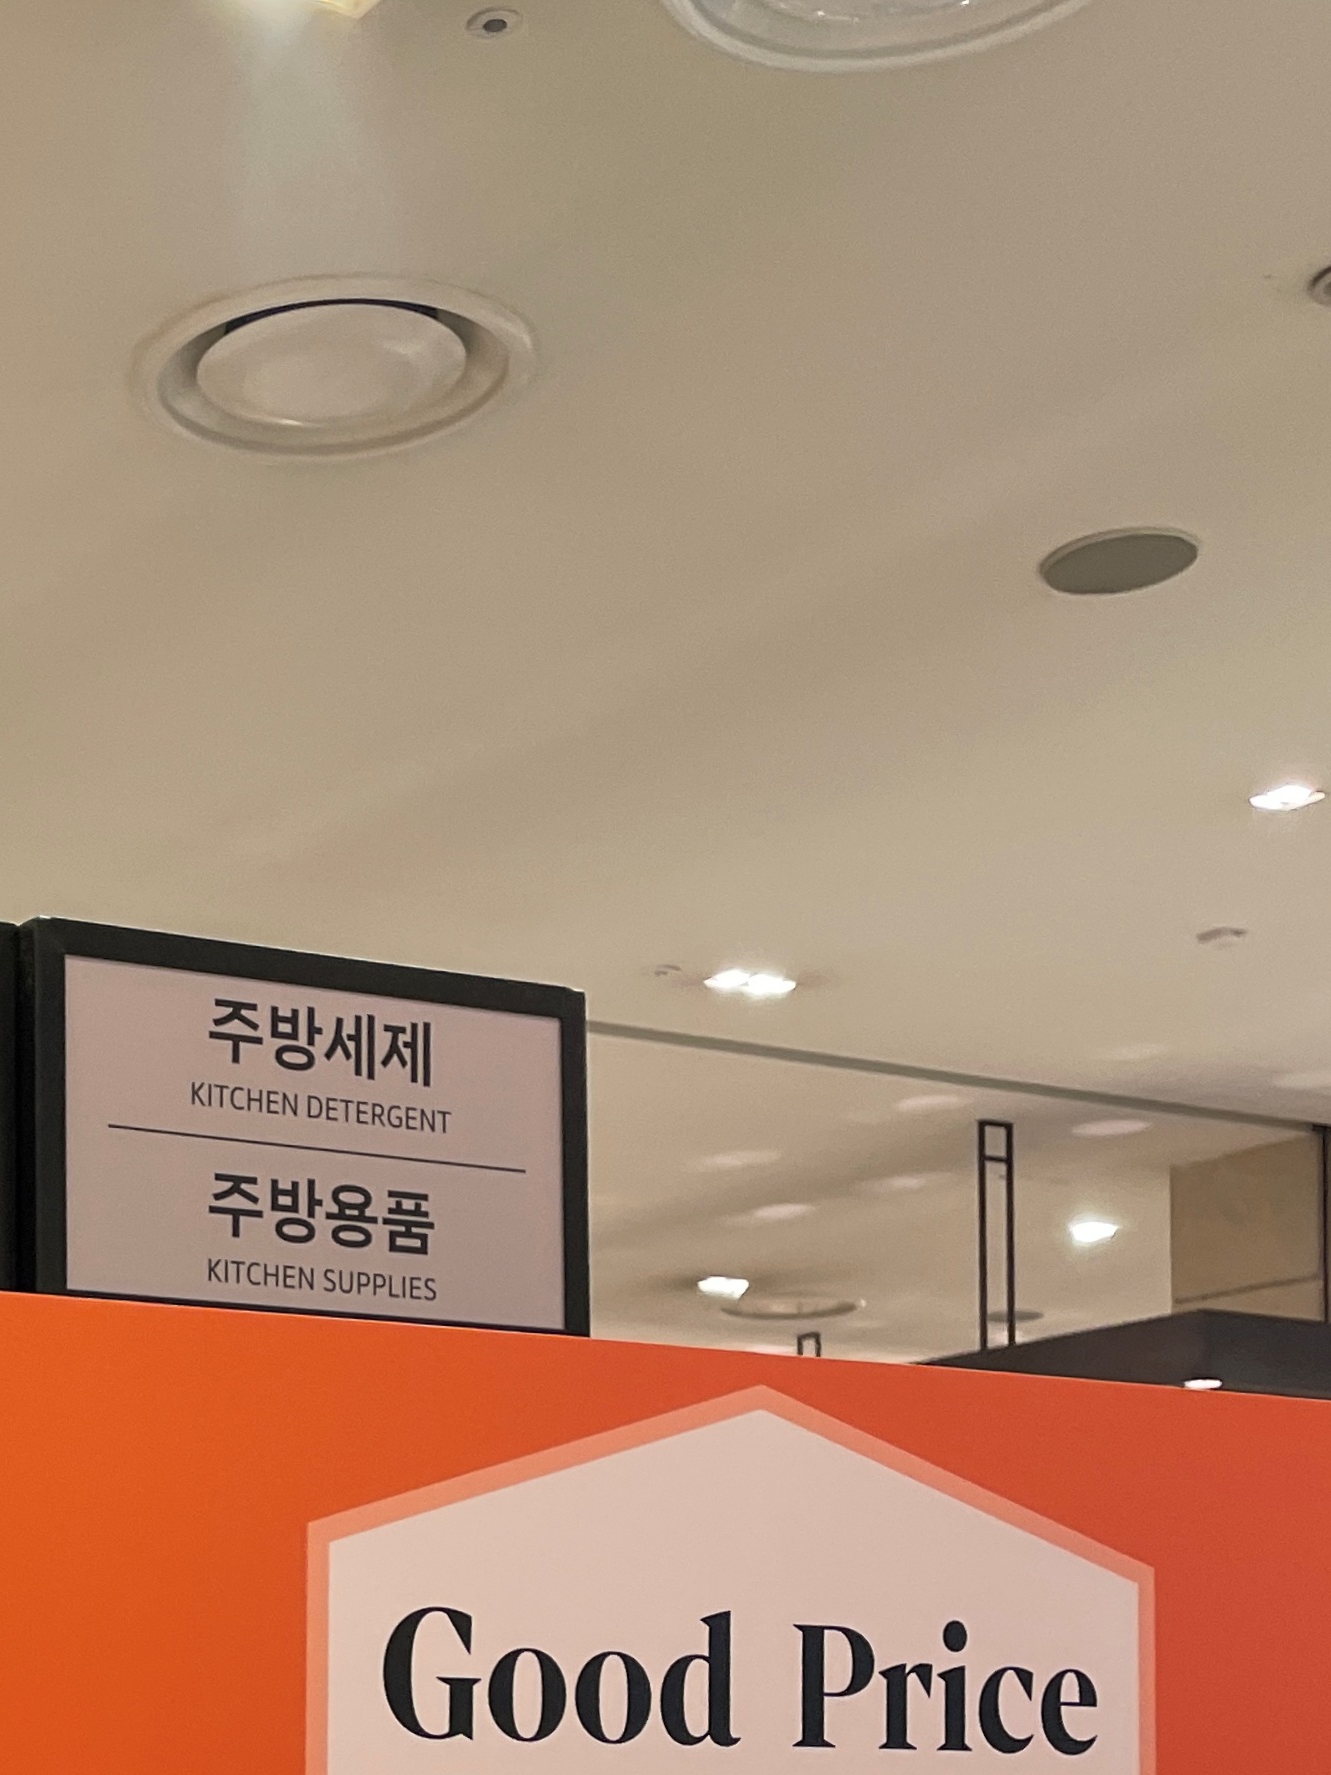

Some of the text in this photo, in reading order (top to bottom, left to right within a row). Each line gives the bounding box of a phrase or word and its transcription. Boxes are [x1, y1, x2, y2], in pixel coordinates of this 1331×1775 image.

[208, 995, 432, 1089] 주방세제
[190, 1080, 451, 1134] KITCHEN DETERGENT
[208, 1170, 434, 1256] 주방용품
[207, 1259, 437, 1302] KITCHEN SUPPLIES
[383, 1606, 1098, 1756] Good Price
